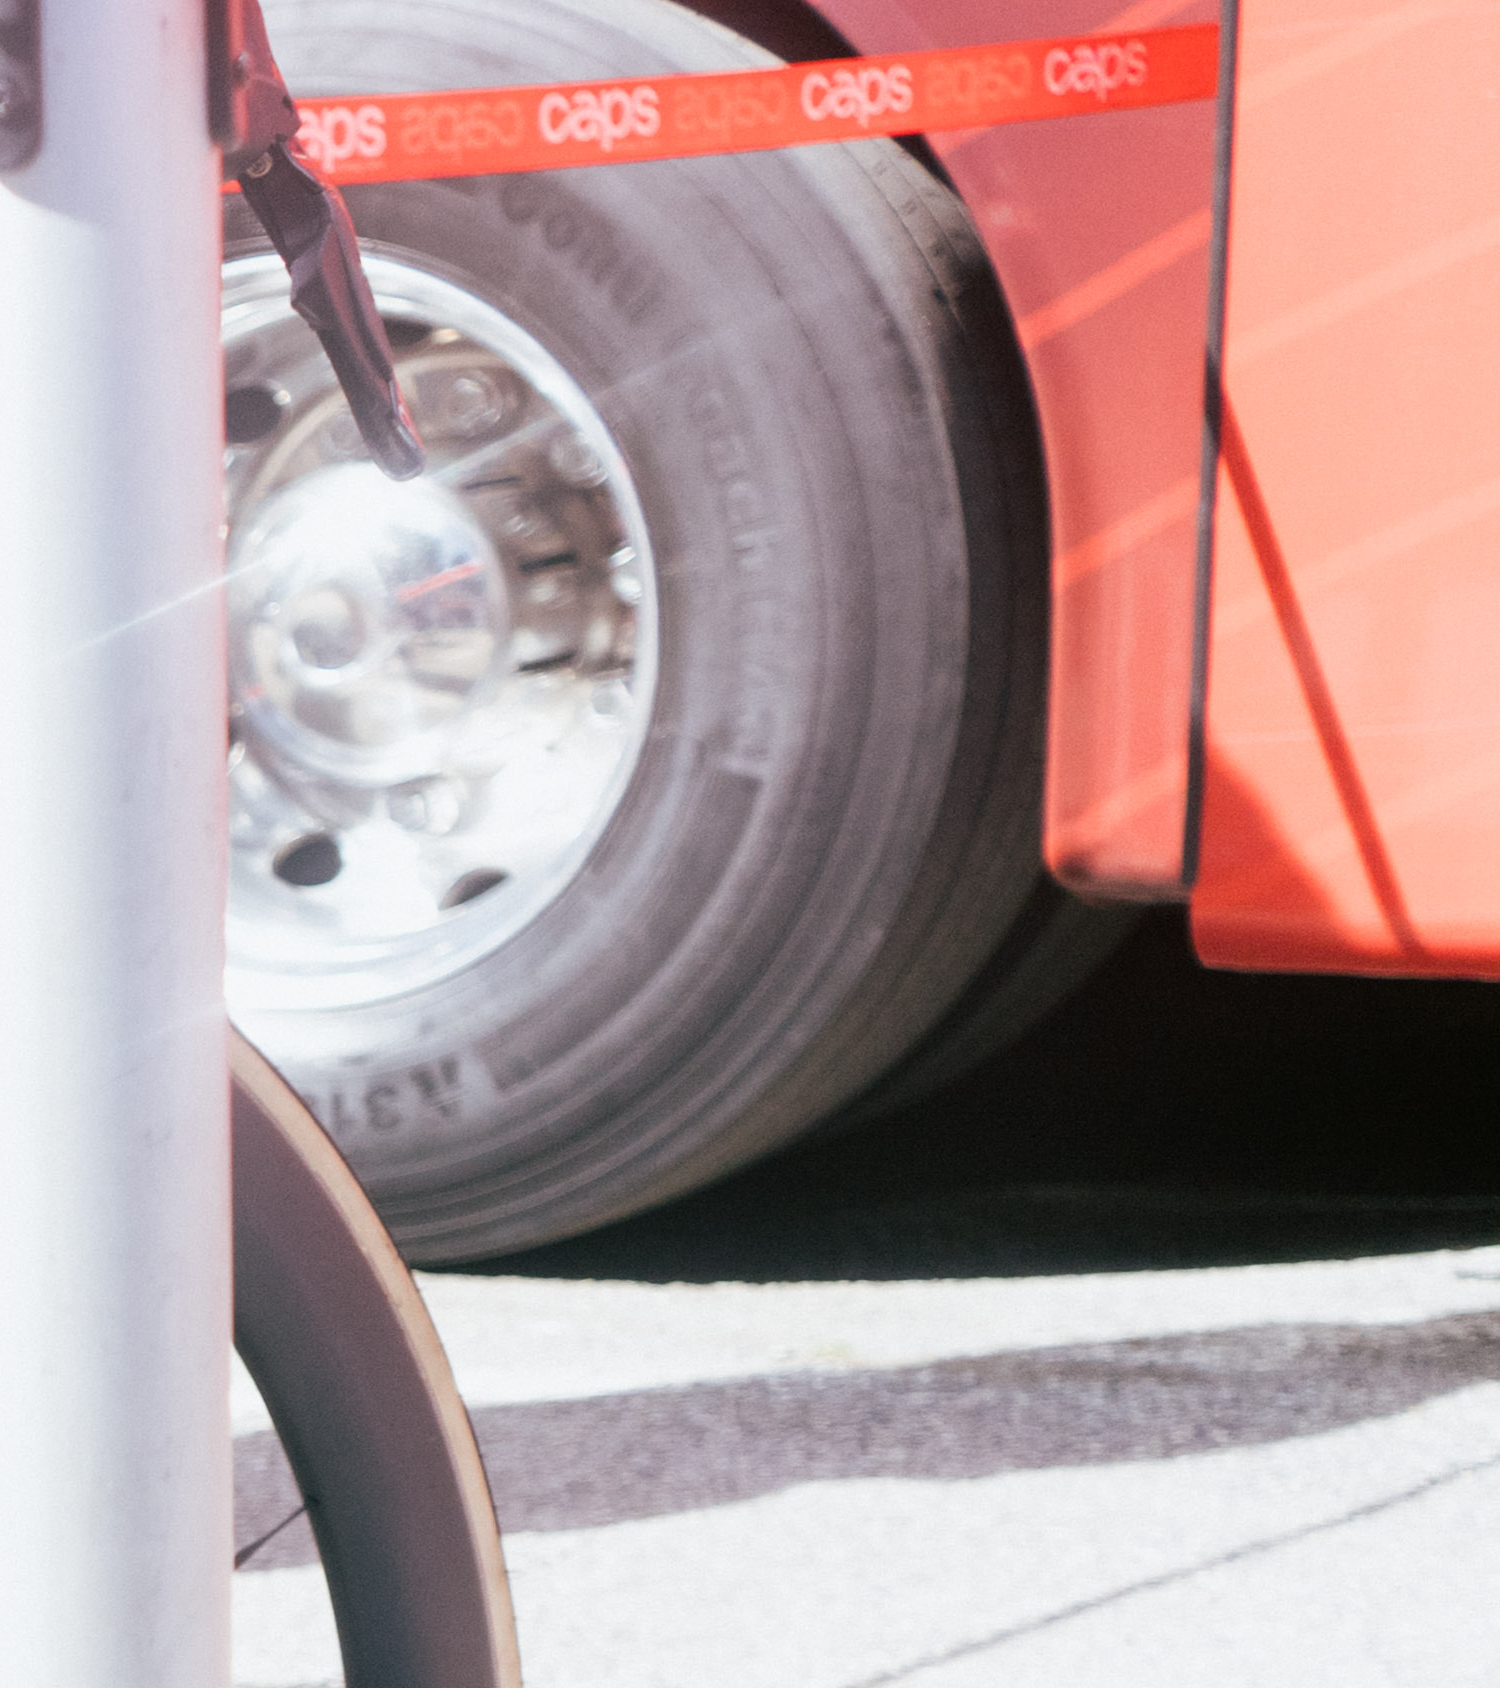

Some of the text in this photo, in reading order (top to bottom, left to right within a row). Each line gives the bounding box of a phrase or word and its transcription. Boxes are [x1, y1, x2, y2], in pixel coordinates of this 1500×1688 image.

[801, 65, 913, 128] caps
[1044, 41, 1148, 100] caps
[299, 104, 387, 172] aps
[539, 85, 662, 152] caps
